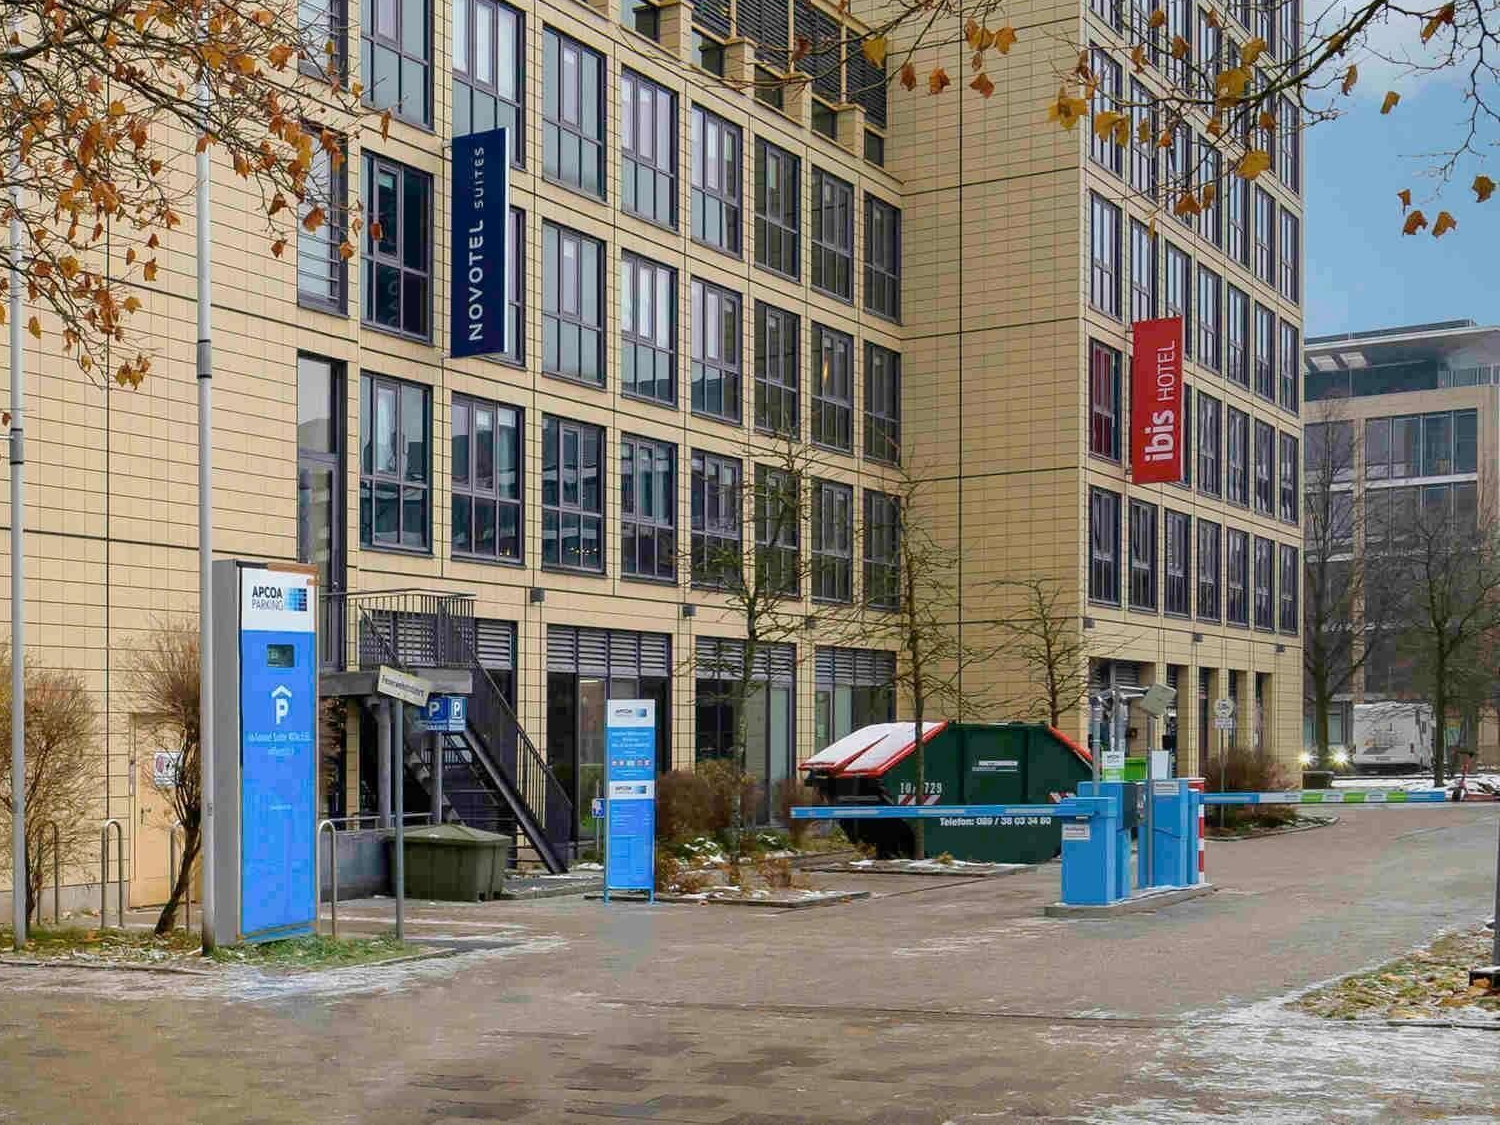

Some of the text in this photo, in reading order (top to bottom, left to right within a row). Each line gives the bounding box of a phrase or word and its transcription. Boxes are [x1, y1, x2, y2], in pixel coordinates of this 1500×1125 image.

[468, 146, 485, 341] NOVOTEL SUITES
[1144, 339, 1176, 463] ibis HOTEL
[251, 585, 284, 599] APCOA
[251, 598, 284, 612] PARKING
[939, 817, 974, 827] Telefon:
